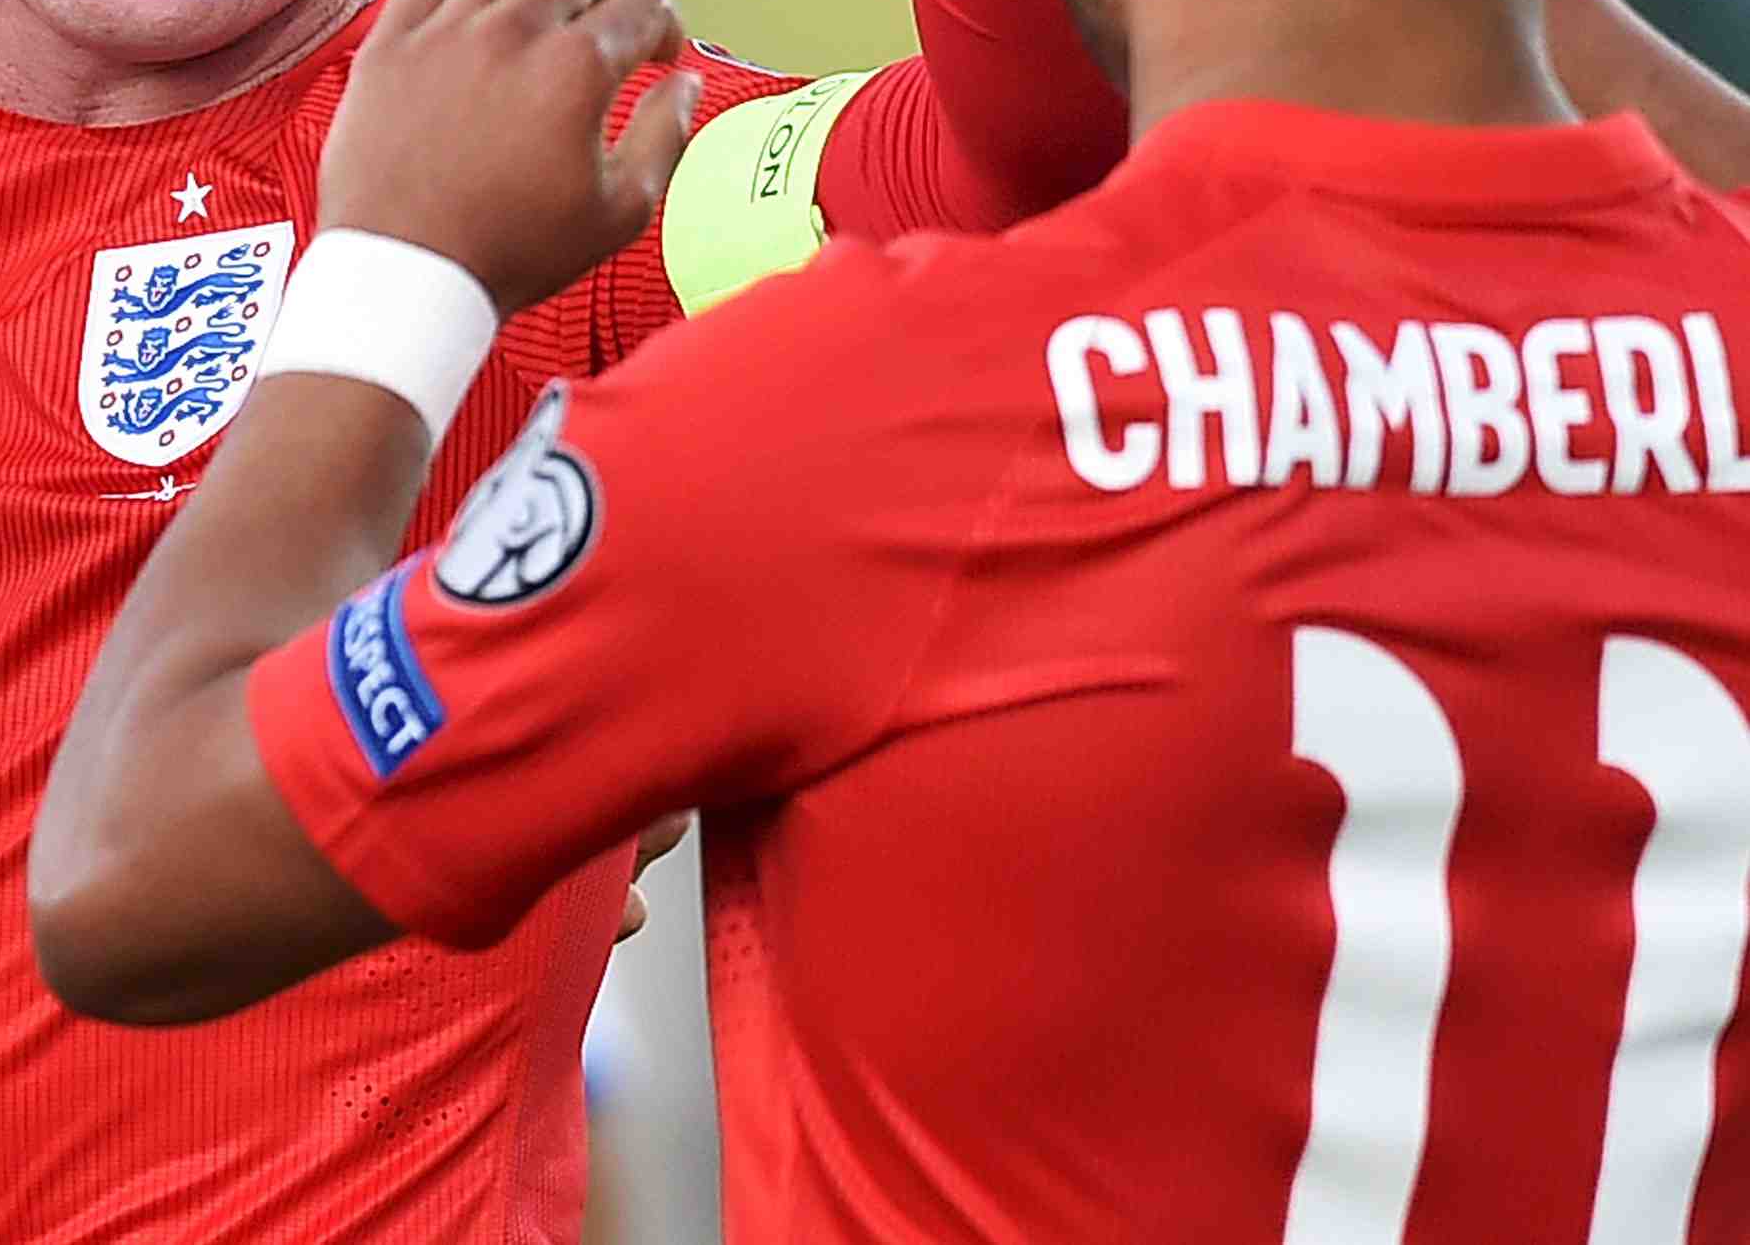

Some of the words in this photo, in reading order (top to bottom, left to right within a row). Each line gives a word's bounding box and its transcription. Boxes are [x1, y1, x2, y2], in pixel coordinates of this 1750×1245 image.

[1046, 307, 1750, 497] CHAMBERL
[344, 590, 428, 754] ESPECT
[1283, 624, 1750, 1245] 11
